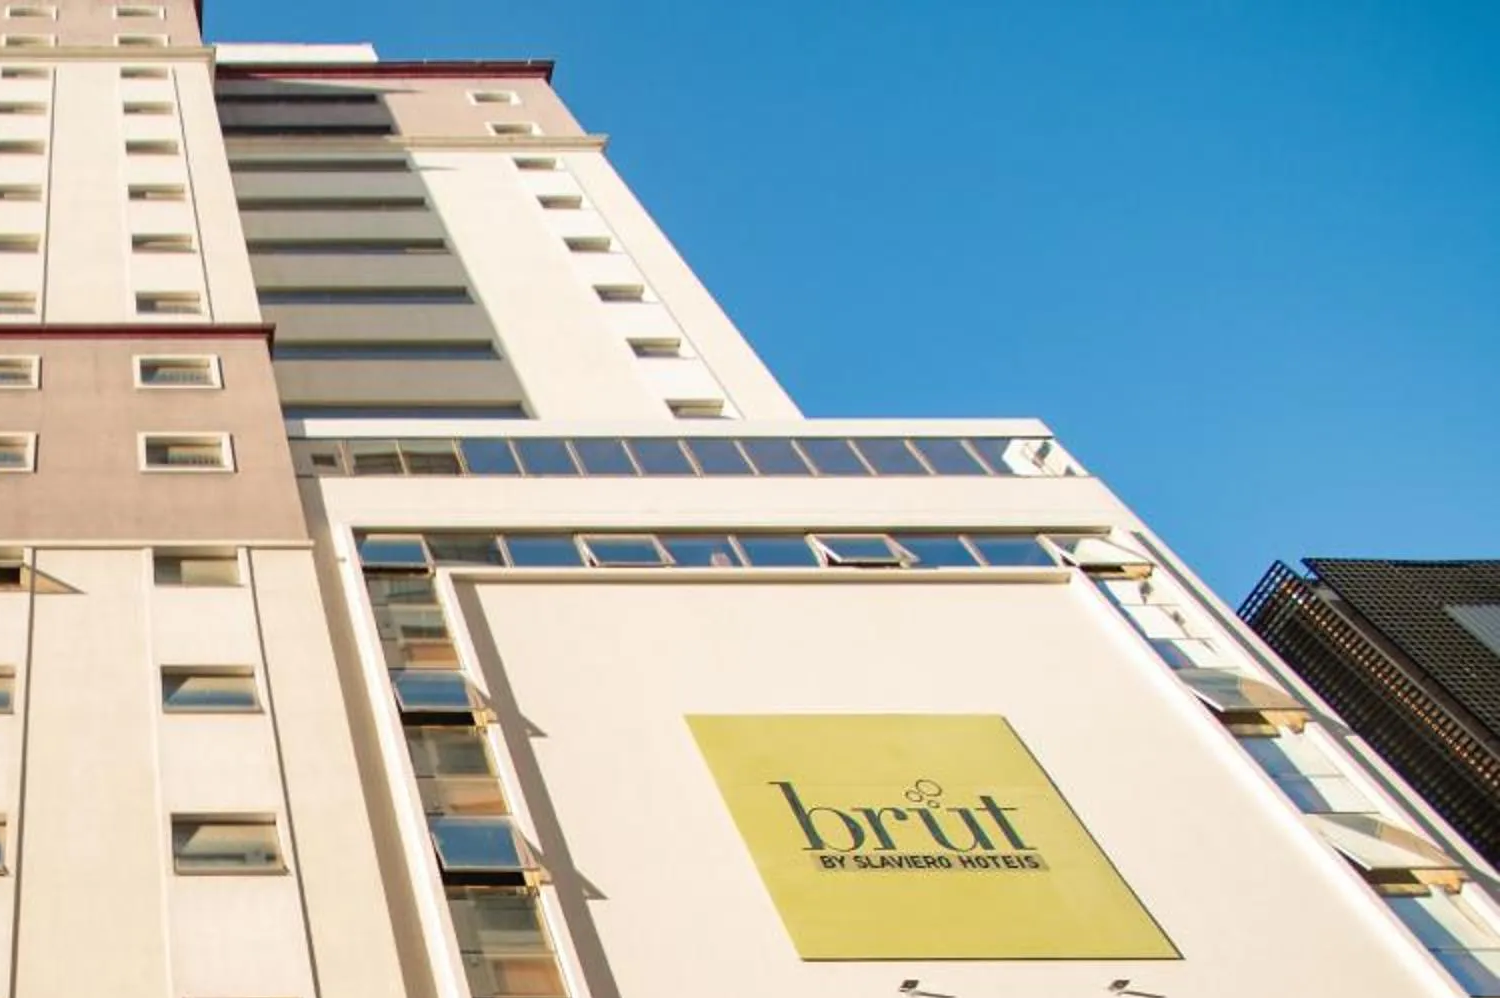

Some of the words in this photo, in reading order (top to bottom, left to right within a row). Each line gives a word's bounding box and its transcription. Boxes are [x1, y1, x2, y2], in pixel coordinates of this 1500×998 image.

[819, 855, 846, 869] BY
[853, 855, 952, 869] SLAVIERO
[960, 855, 1041, 869] HOTEIS
